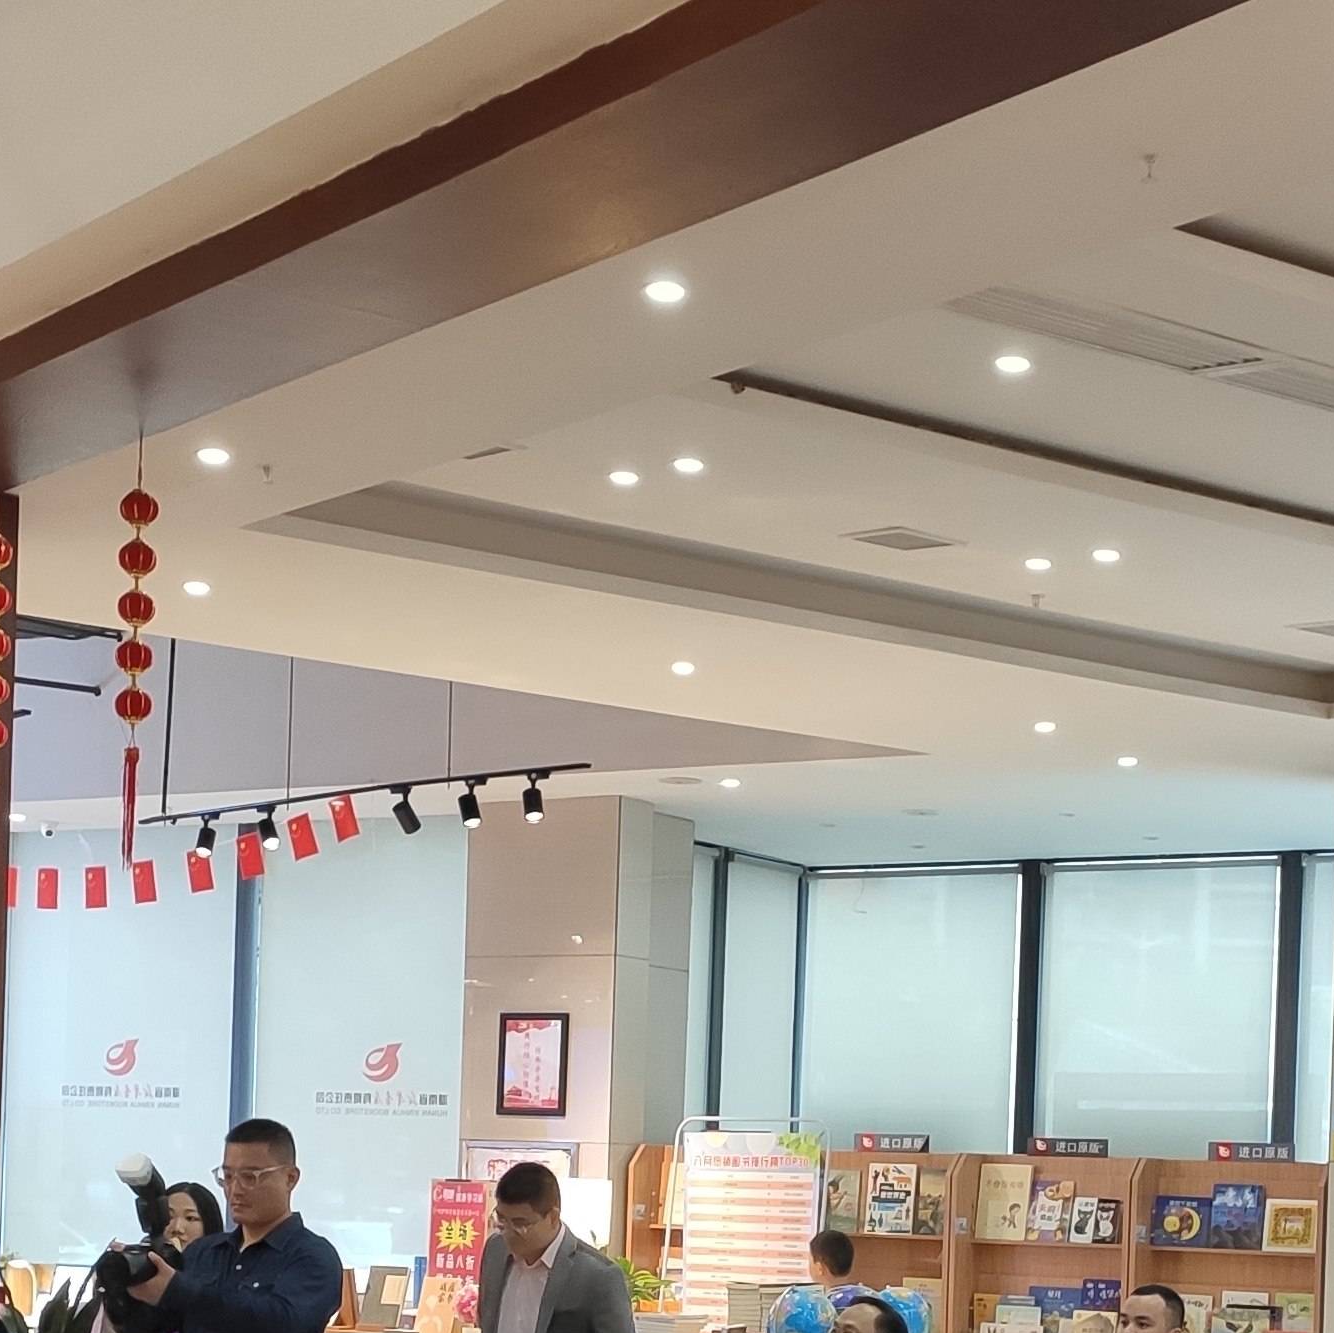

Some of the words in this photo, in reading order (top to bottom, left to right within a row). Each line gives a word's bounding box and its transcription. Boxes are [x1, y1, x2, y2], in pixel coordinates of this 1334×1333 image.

[880, 1136, 925, 1149] 进口原版
[1055, 1141, 1100, 1153] 进口原版
[1238, 1146, 1289, 1159] 进口原版
